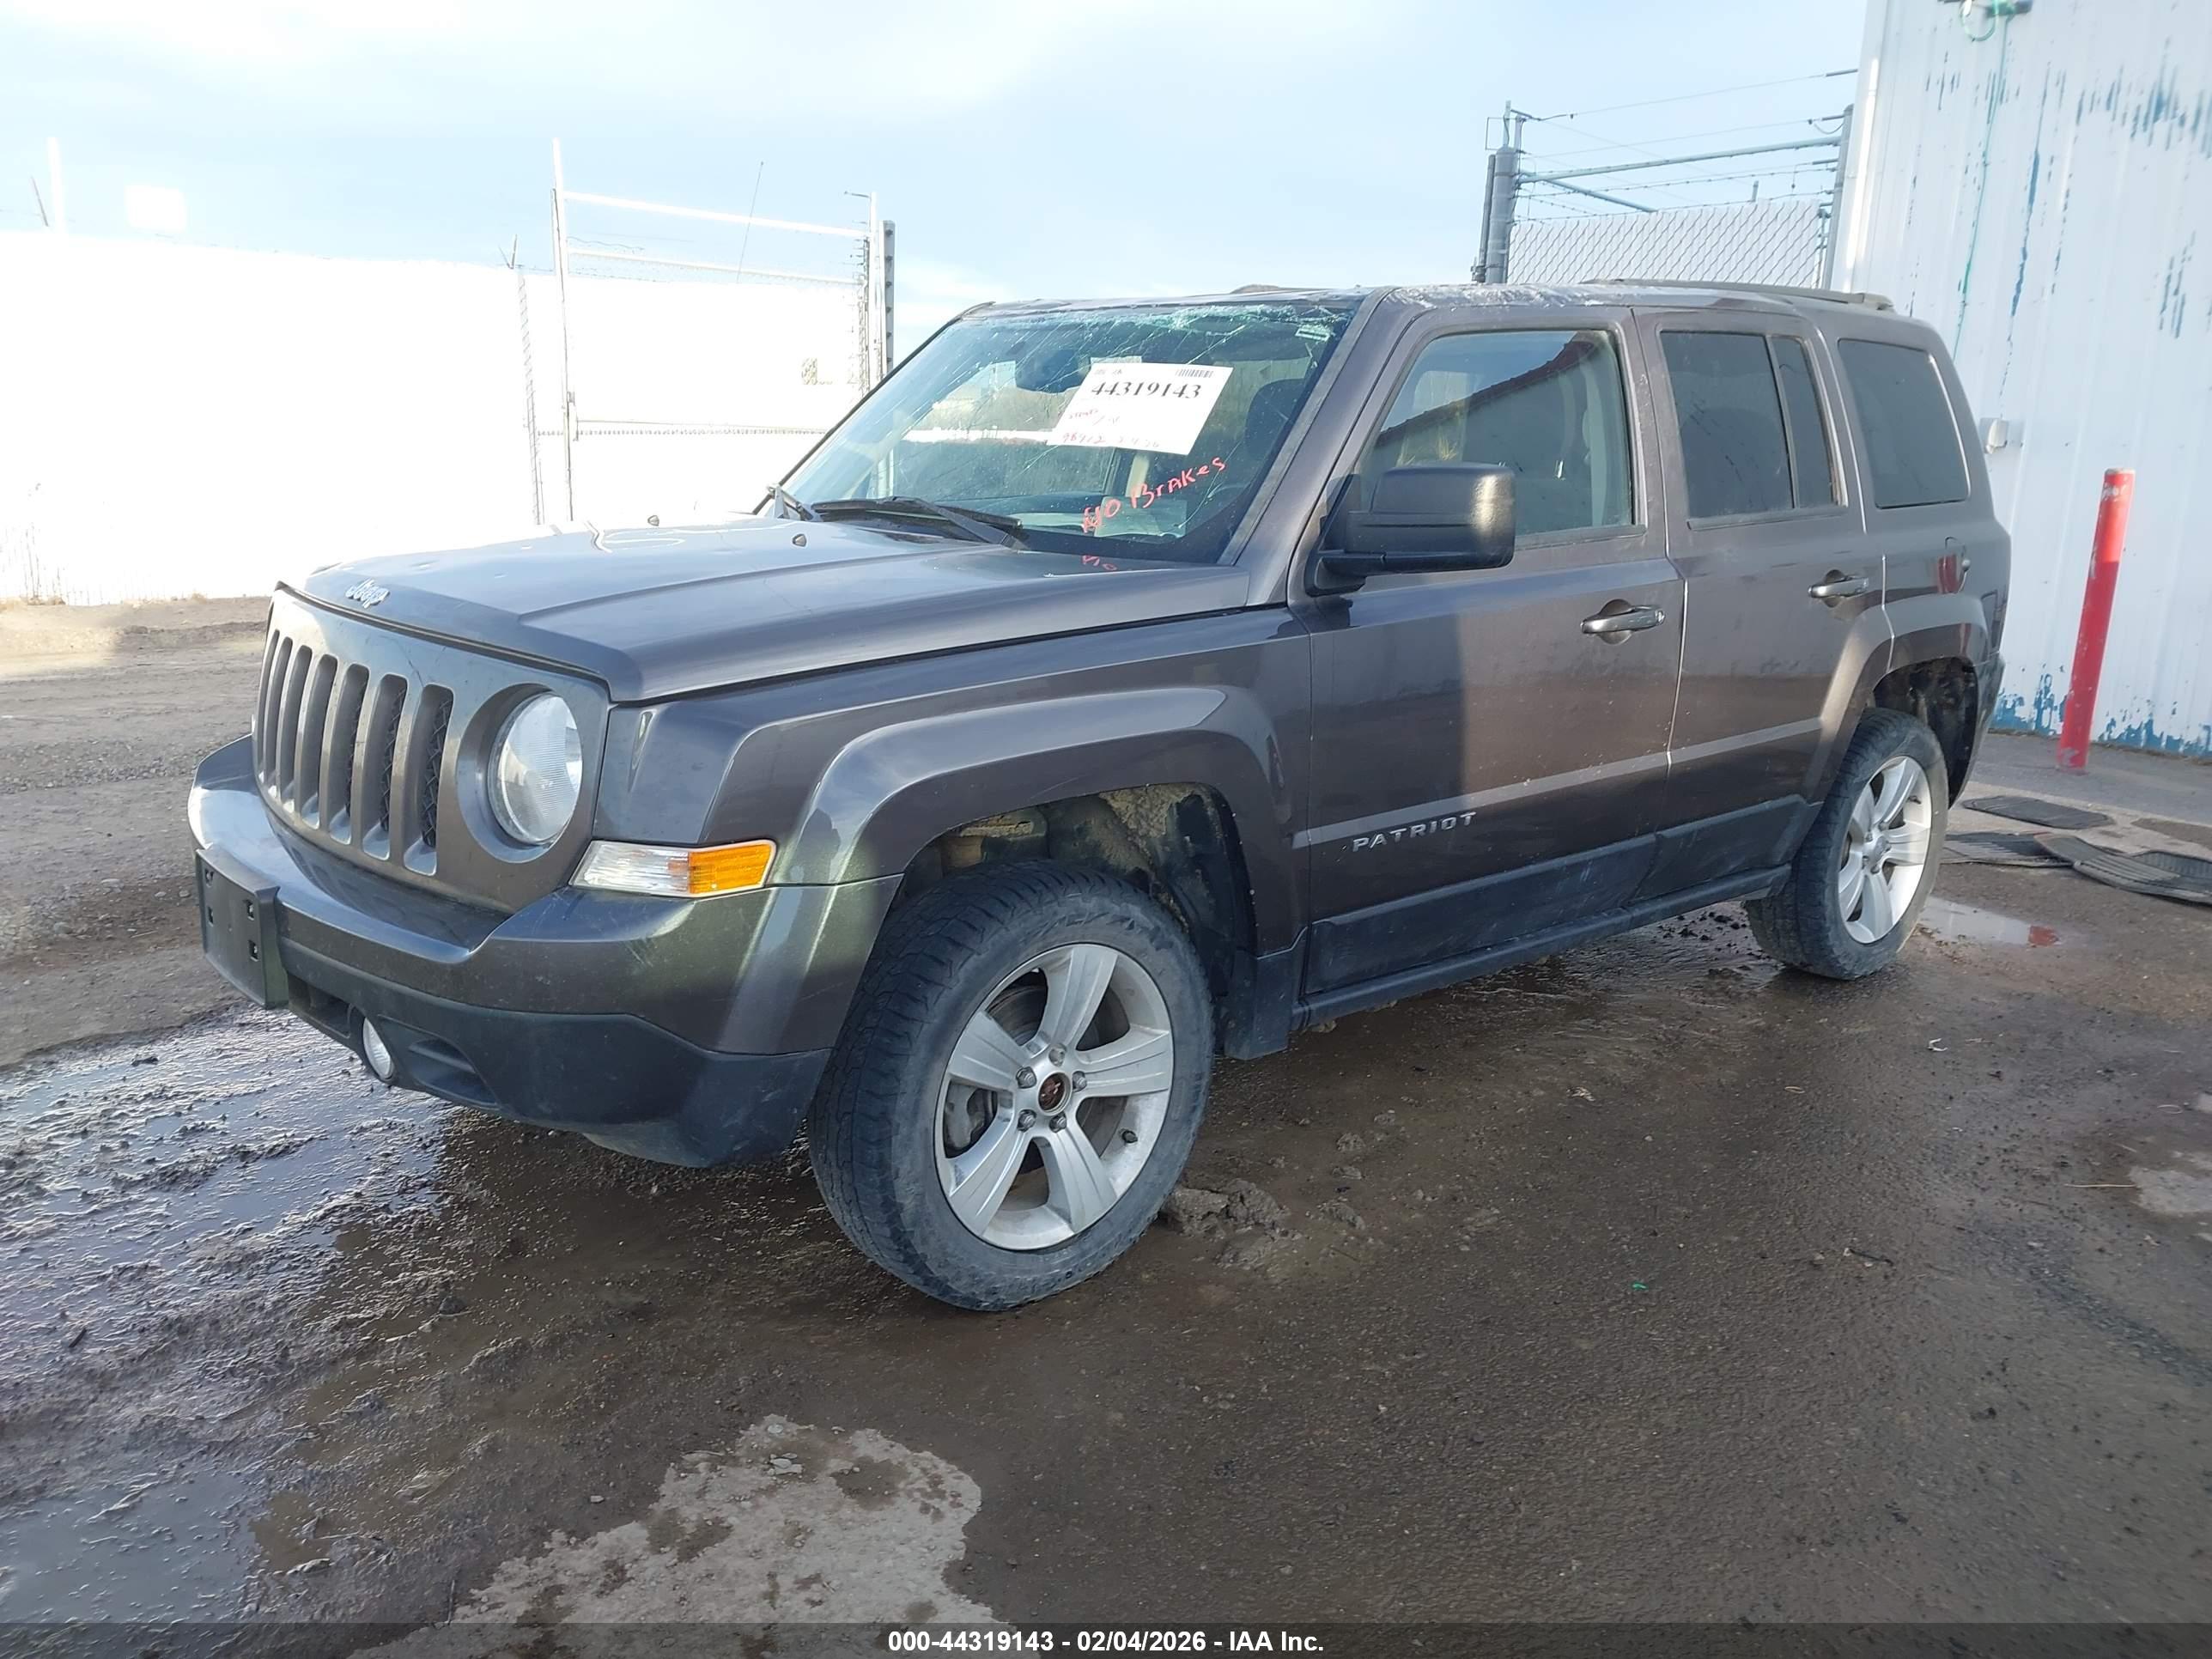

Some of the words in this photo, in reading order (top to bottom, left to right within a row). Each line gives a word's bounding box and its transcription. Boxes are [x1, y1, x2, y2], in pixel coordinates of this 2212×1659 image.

[1091, 381, 1201, 398] 44319143
[345, 578, 391, 608] Jeep
[1352, 811, 1477, 852] PATRIOT
